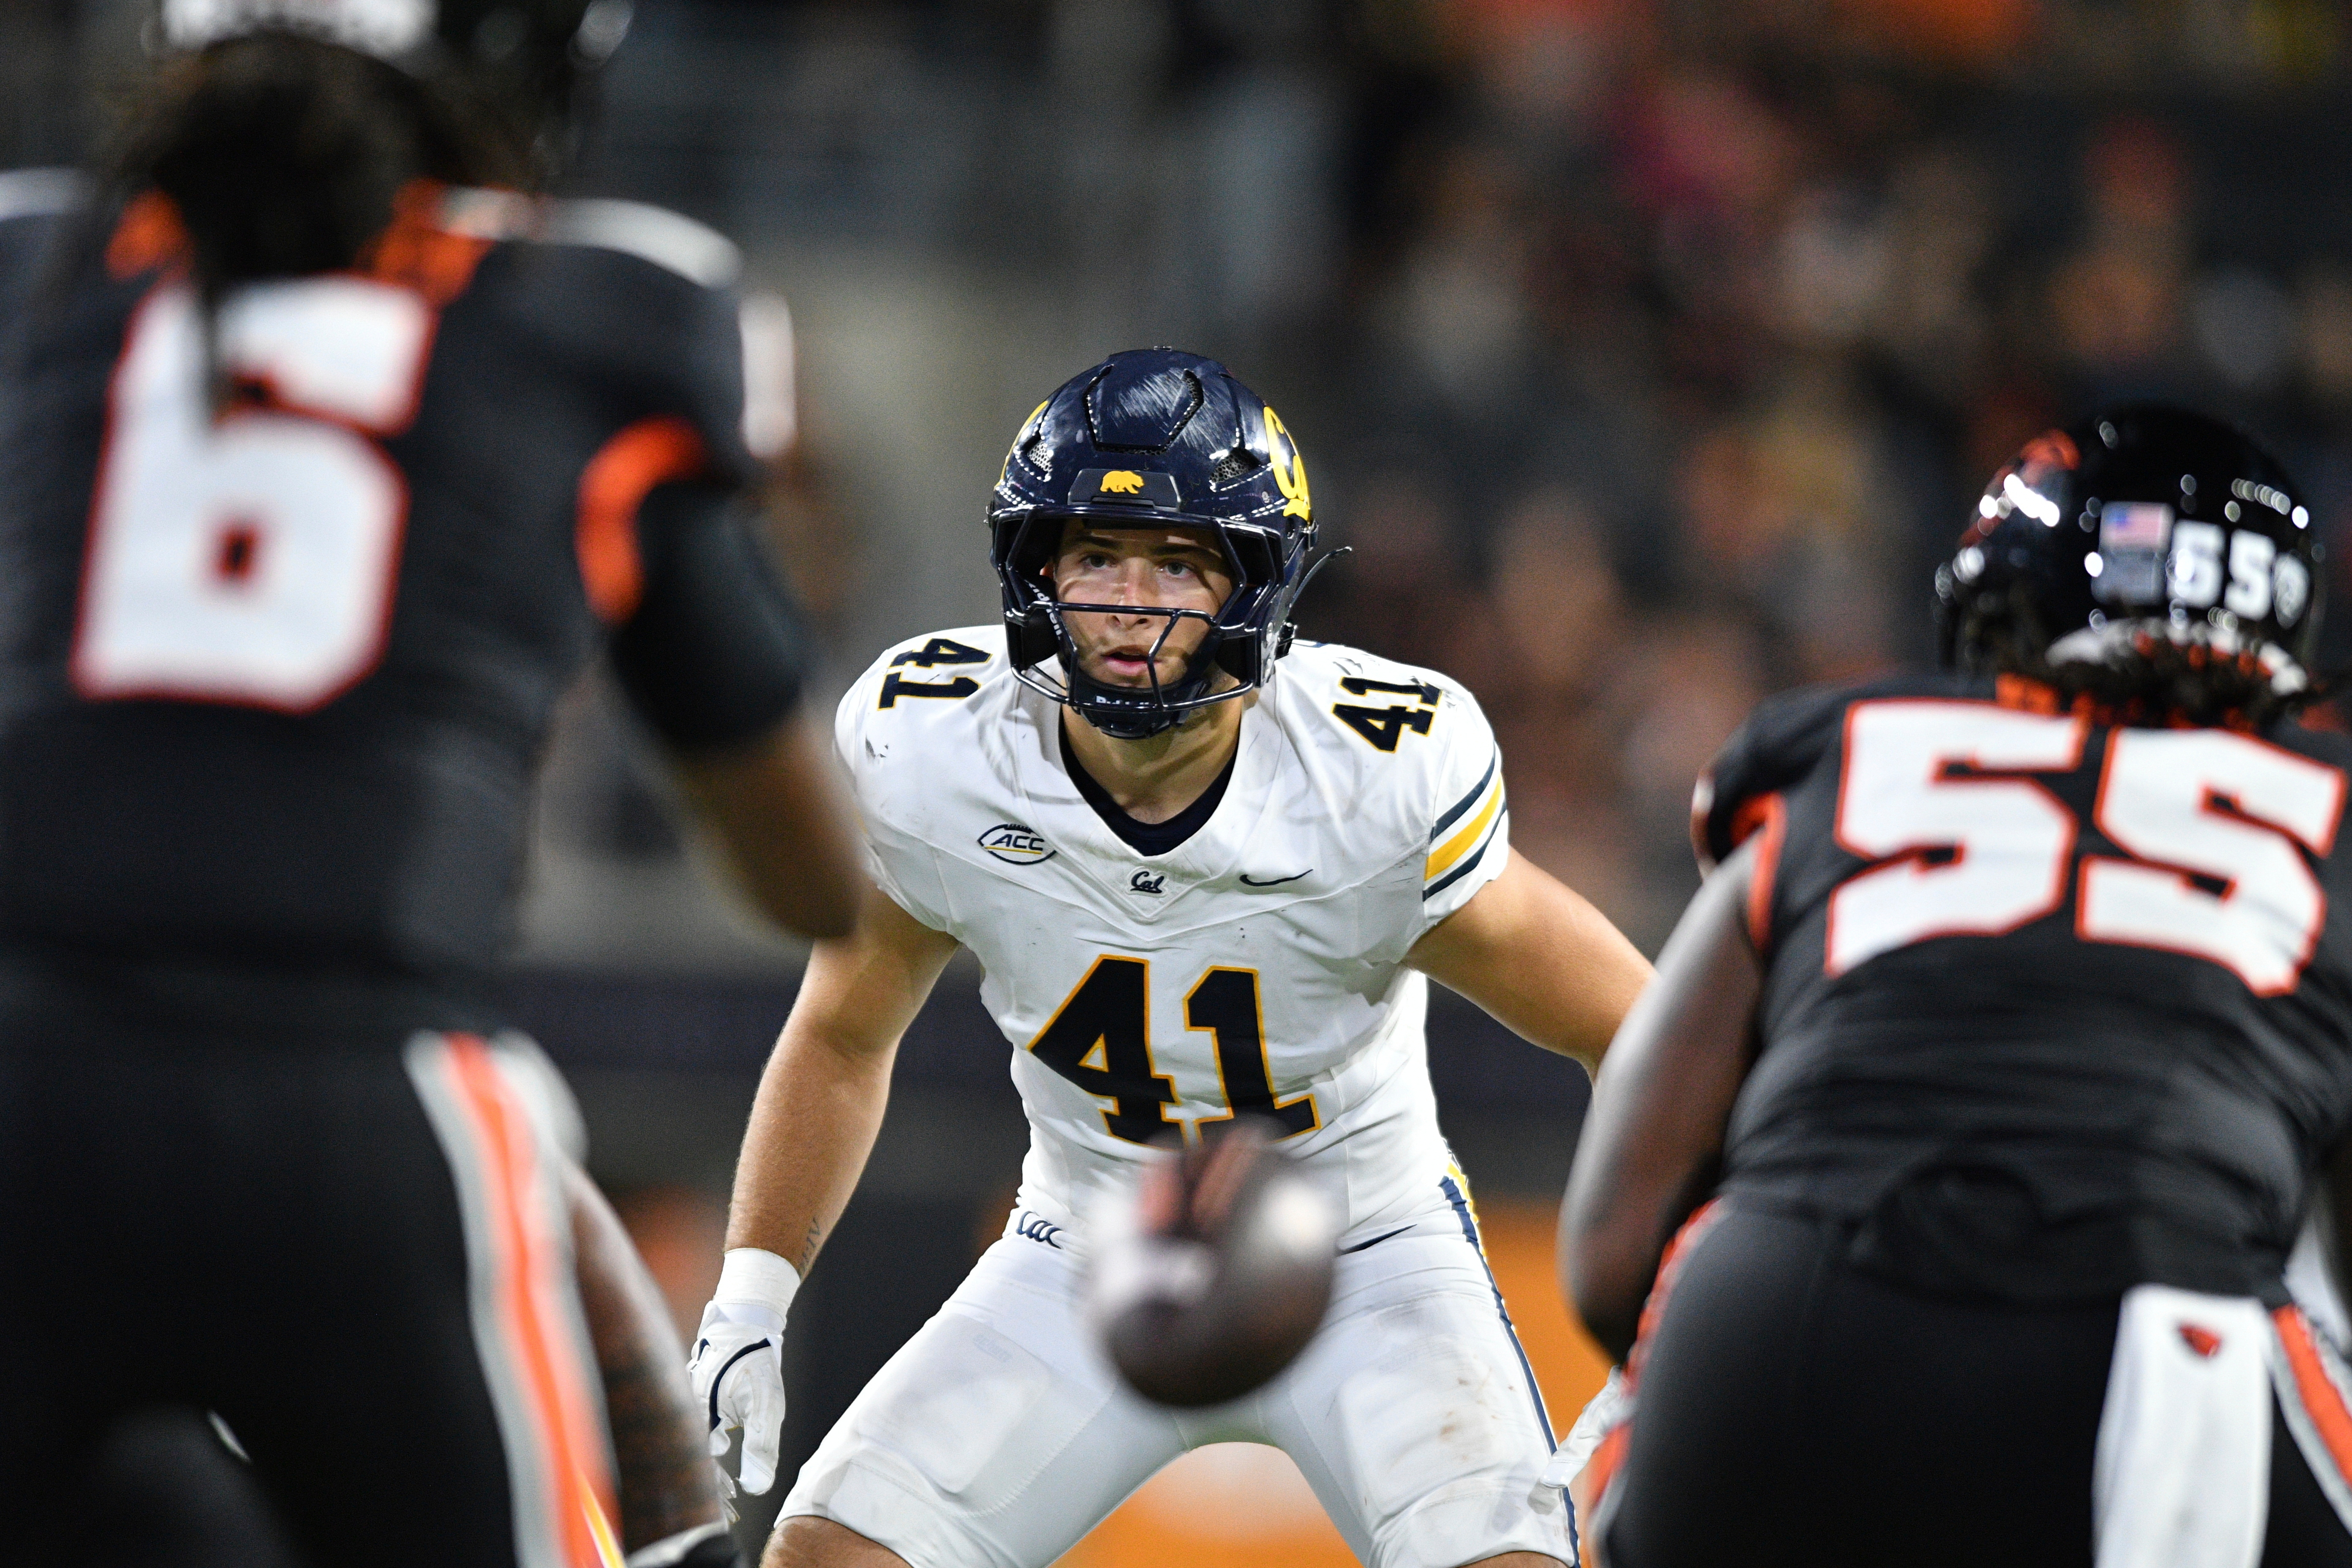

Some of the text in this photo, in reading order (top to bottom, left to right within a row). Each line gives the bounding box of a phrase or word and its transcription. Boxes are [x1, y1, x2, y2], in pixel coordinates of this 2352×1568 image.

[68, 270, 442, 717] 6
[877, 637, 993, 710] 41
[1331, 676, 1443, 753] 41
[991, 833, 1045, 851] ACC
[1824, 696, 2349, 998] 55
[1130, 871, 1165, 894] Cal
[1026, 954, 1322, 1152] 41
